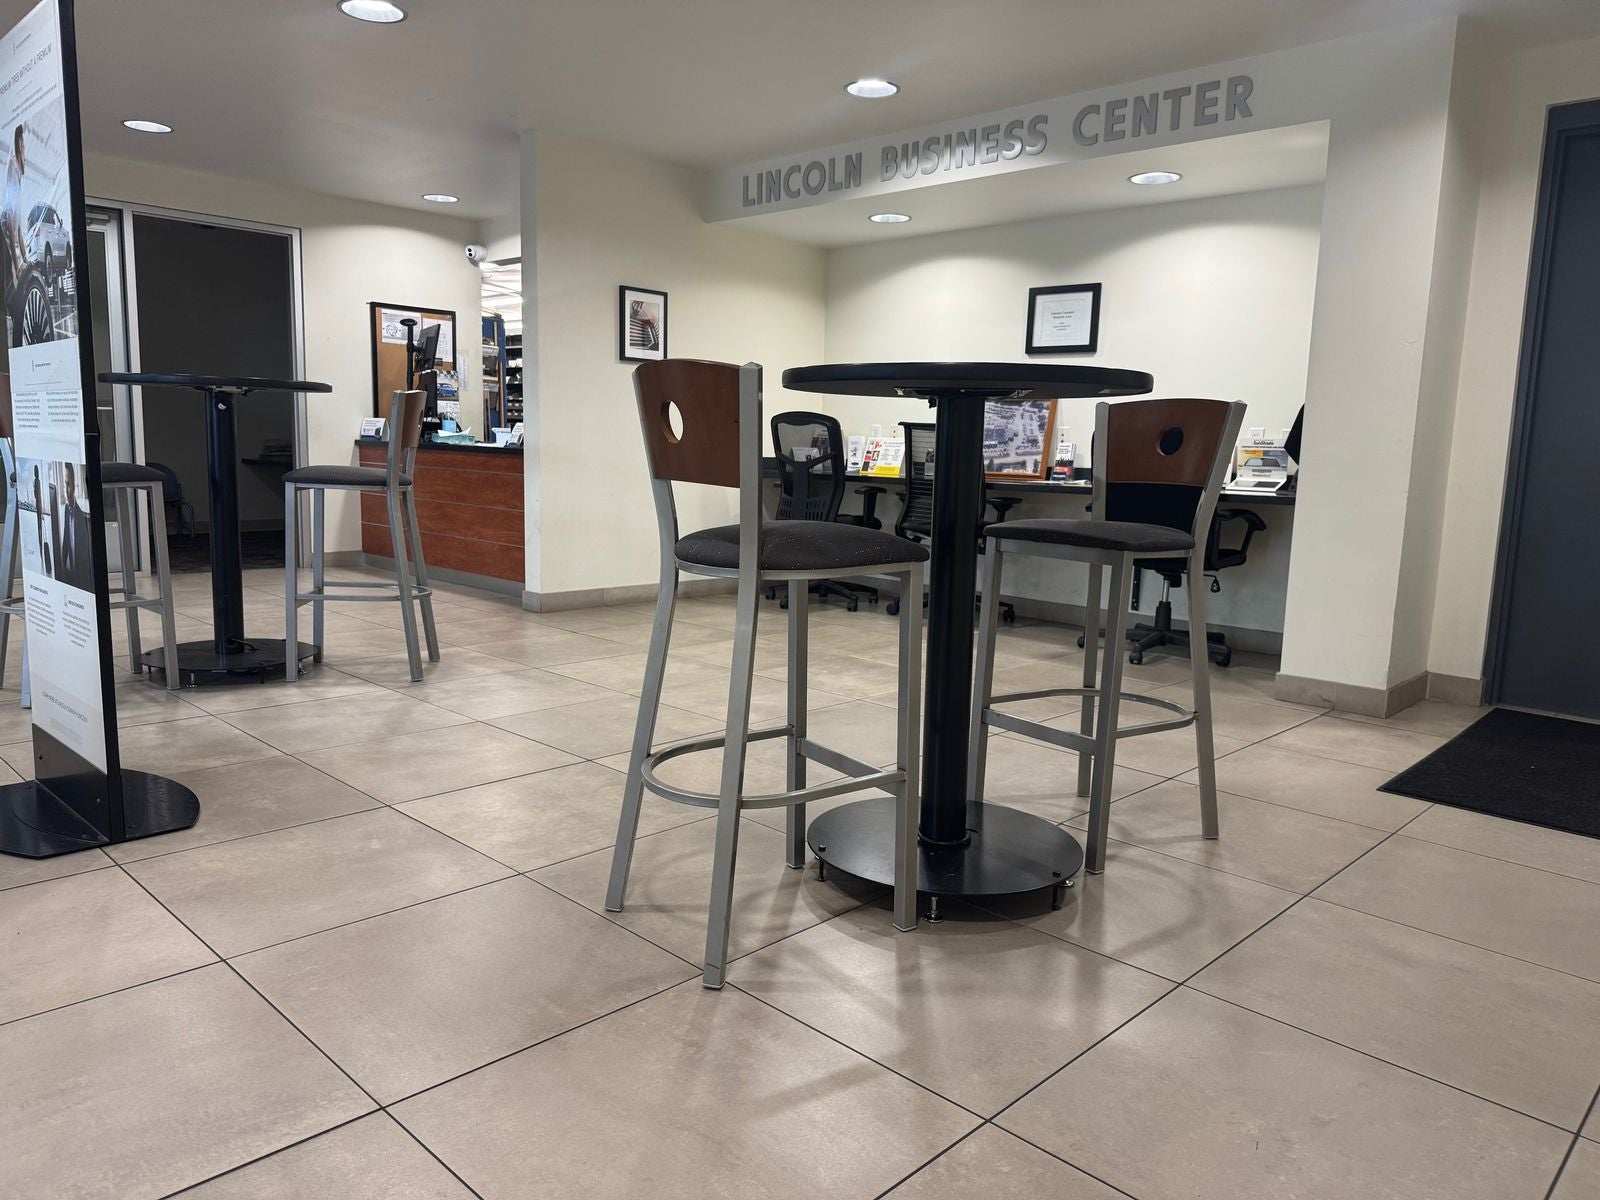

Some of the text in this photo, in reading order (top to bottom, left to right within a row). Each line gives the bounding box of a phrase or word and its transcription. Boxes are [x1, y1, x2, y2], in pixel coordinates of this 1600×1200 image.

[742, 75, 1253, 208] LINCOLN BUSINESS CENTER
